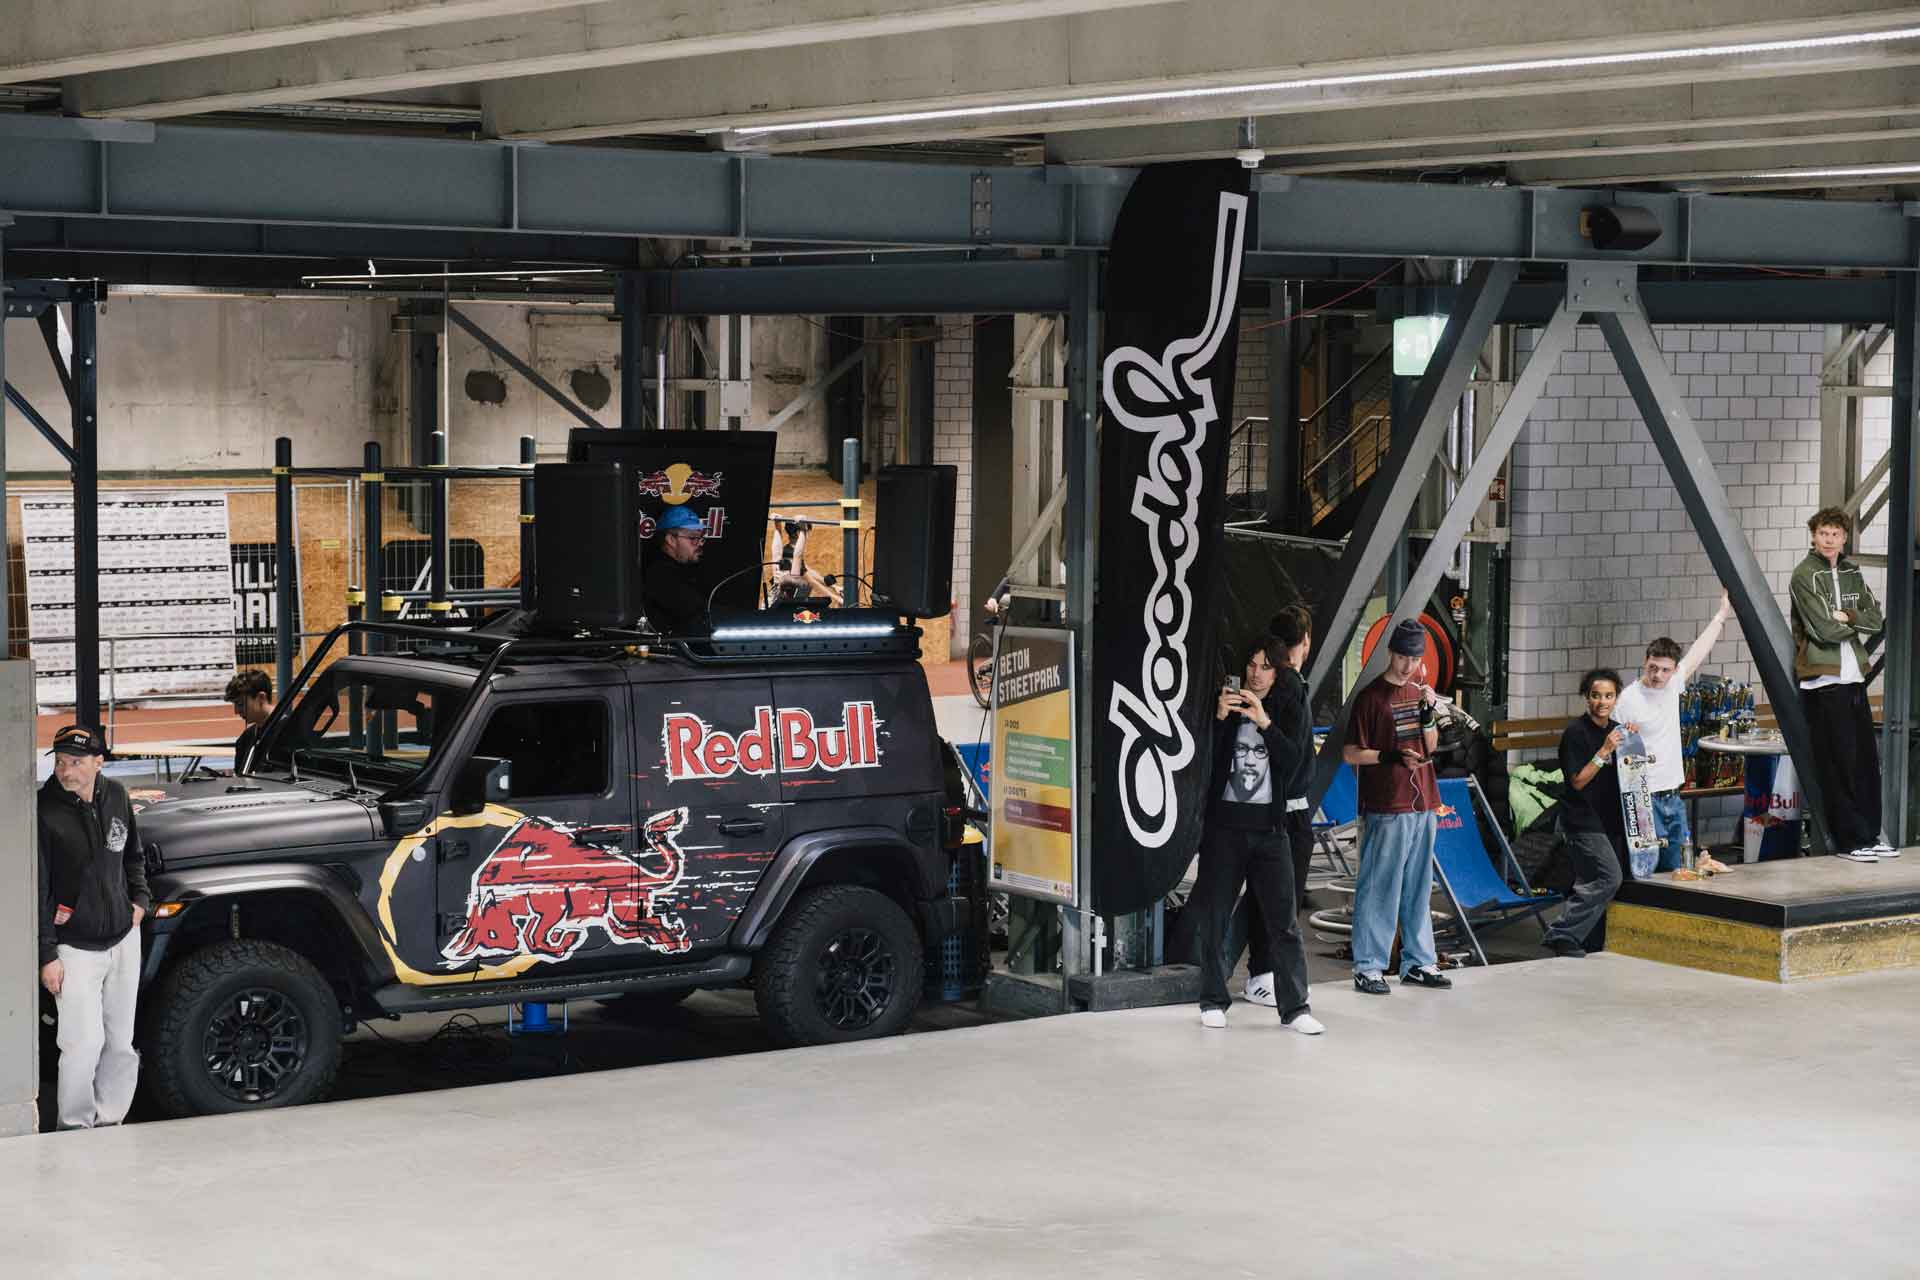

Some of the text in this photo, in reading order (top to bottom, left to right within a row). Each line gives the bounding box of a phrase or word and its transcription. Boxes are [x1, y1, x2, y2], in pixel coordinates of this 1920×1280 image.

[1103, 192, 1248, 848] doodah
[1000, 647, 1030, 677] BETON
[999, 664, 1061, 703] STREETPARK
[663, 700, 882, 780] Red Bull
[1769, 791, 1800, 809] Bull
